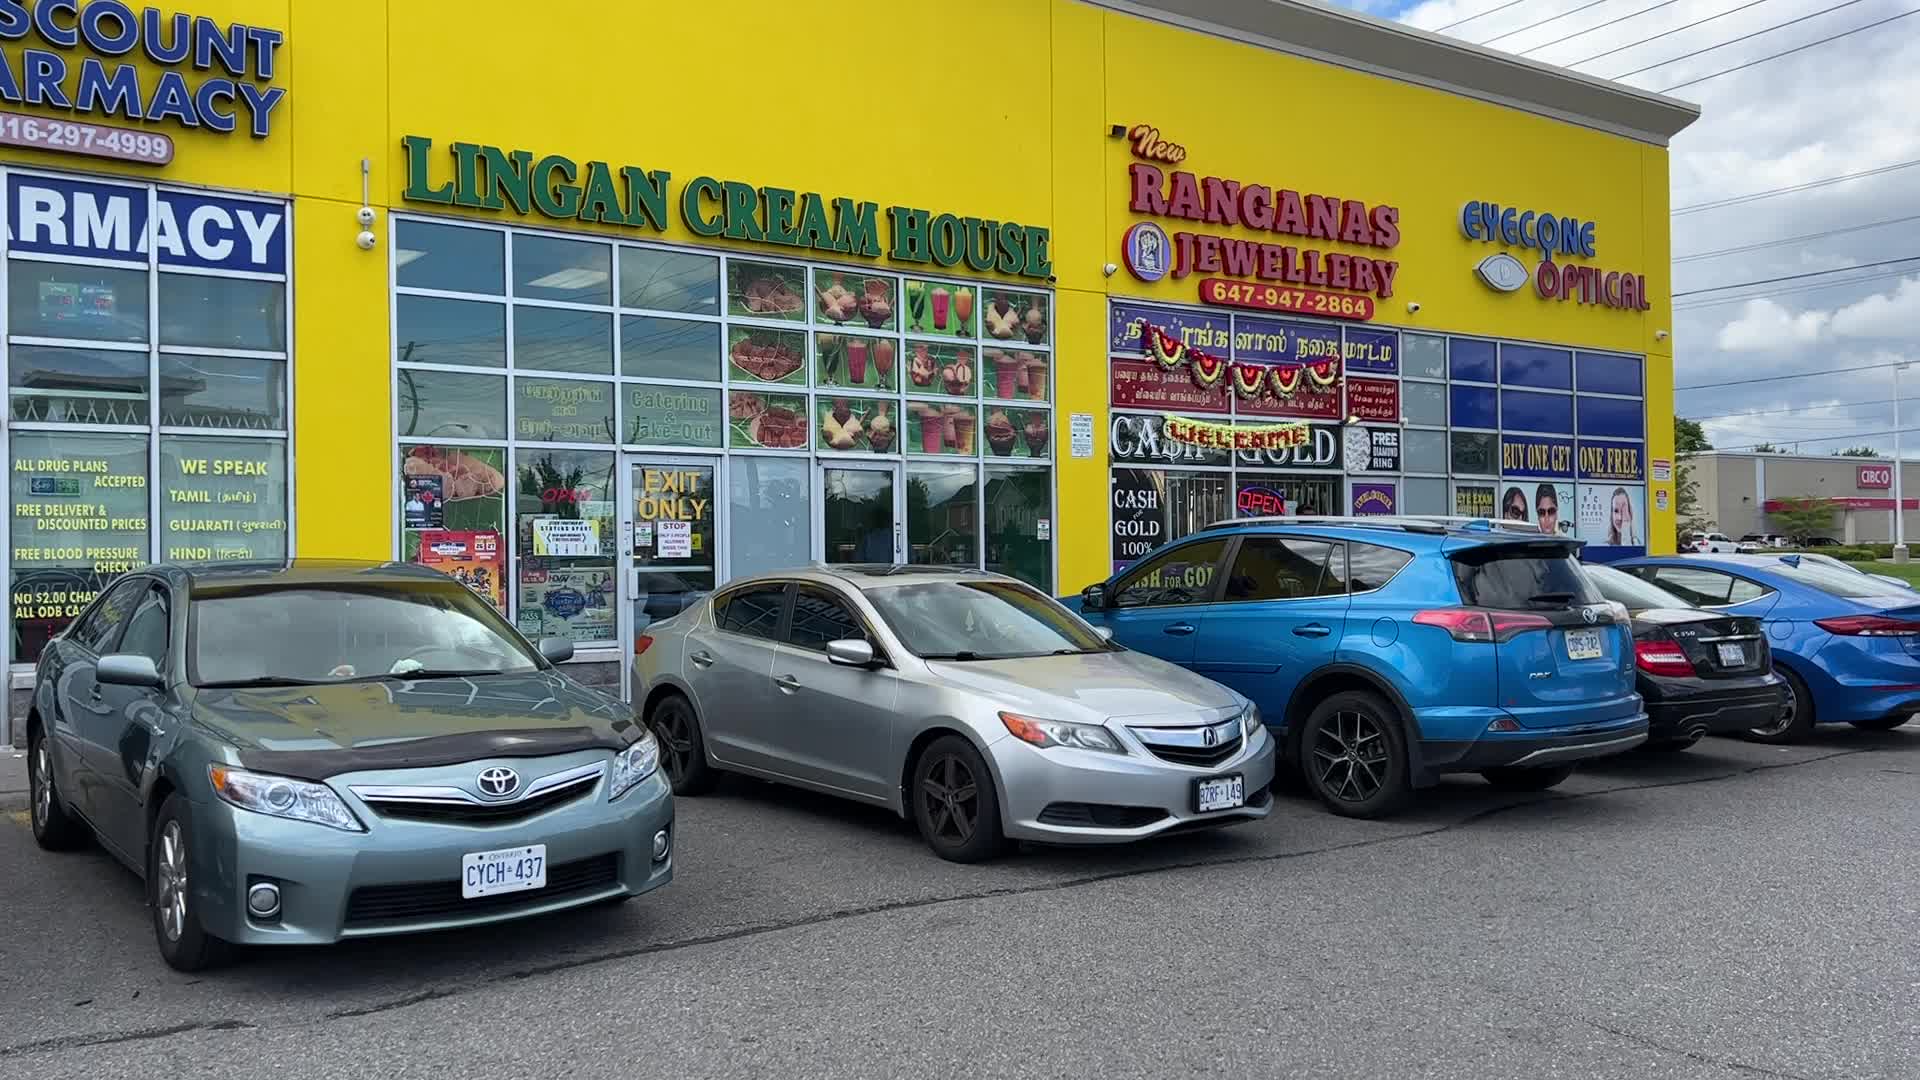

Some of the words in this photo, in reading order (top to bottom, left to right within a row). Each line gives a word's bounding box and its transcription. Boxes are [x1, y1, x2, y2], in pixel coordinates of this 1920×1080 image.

[0, 115, 168, 159] 16-297-4999
[1128, 124, 1187, 163] New
[401, 135, 671, 230] LINGAN
[681, 176, 881, 258] CREAM
[887, 206, 1052, 277] HOUSE
[1129, 163, 1400, 248] RANGANAS
[8, 185, 281, 264] RMACY
[1460, 200, 1596, 260] EYECONE
[1171, 232, 1399, 298] JEWELLERY
[1536, 260, 1651, 311] OPTICAL
[1213, 282, 1367, 316] 647-947-2864
[631, 389, 710, 414] Catering
[664, 412, 676, 424] &
[1373, 432, 1397, 446] FREE
[1373, 446, 1398, 457] DIAMOND
[1504, 443, 1525, 469] BUY
[1528, 444, 1549, 471] ONE
[1552, 445, 1571, 472] GET
[1580, 446, 1604, 472] ONE
[15, 460, 34, 471] ALL
[38, 460, 70, 472] DRUG
[73, 460, 108, 472] PLANS
[181, 459, 208, 474] WE
[213, 460, 268, 475] SPEAK
[1373, 458, 1393, 468] RING
[94, 476, 145, 487] ACCEPTED
[644, 470, 702, 492] EXIT
[1862, 471, 1881, 484] CIBC
[169, 489, 211, 502] TAMIL
[1115, 489, 1158, 509] CASH
[1238, 491, 1286, 513] OPEN
[15, 504, 41, 516] FREE
[44, 504, 95, 516] DELIVERY
[98, 504, 106, 516] &
[639, 498, 706, 519] ONLY
[37, 519, 108, 530] DISCOUNTED
[112, 519, 146, 530] PRICES
[169, 519, 233, 531] GUJARATI
[663, 522, 686, 530] STOP
[1115, 520, 1160, 536] GOLD
[14, 549, 40, 560] FREE
[44, 548, 83, 560] BLOOD
[87, 548, 138, 560] PRESSURE
[169, 547, 211, 560] HINDI
[1122, 541, 1153, 556] 100%
[94, 561, 129, 573] CHECK
[1164, 576, 1181, 587] FOR
[14, 593, 32, 604] NO
[36, 592, 66, 604] $2.00
[15, 606, 35, 618] ALL
[38, 606, 62, 617] ODB
[65, 605, 85, 617] CA
[1226, 783, 1242, 800] 149
[467, 862, 505, 886] CYCH
[515, 856, 542, 879] 437
